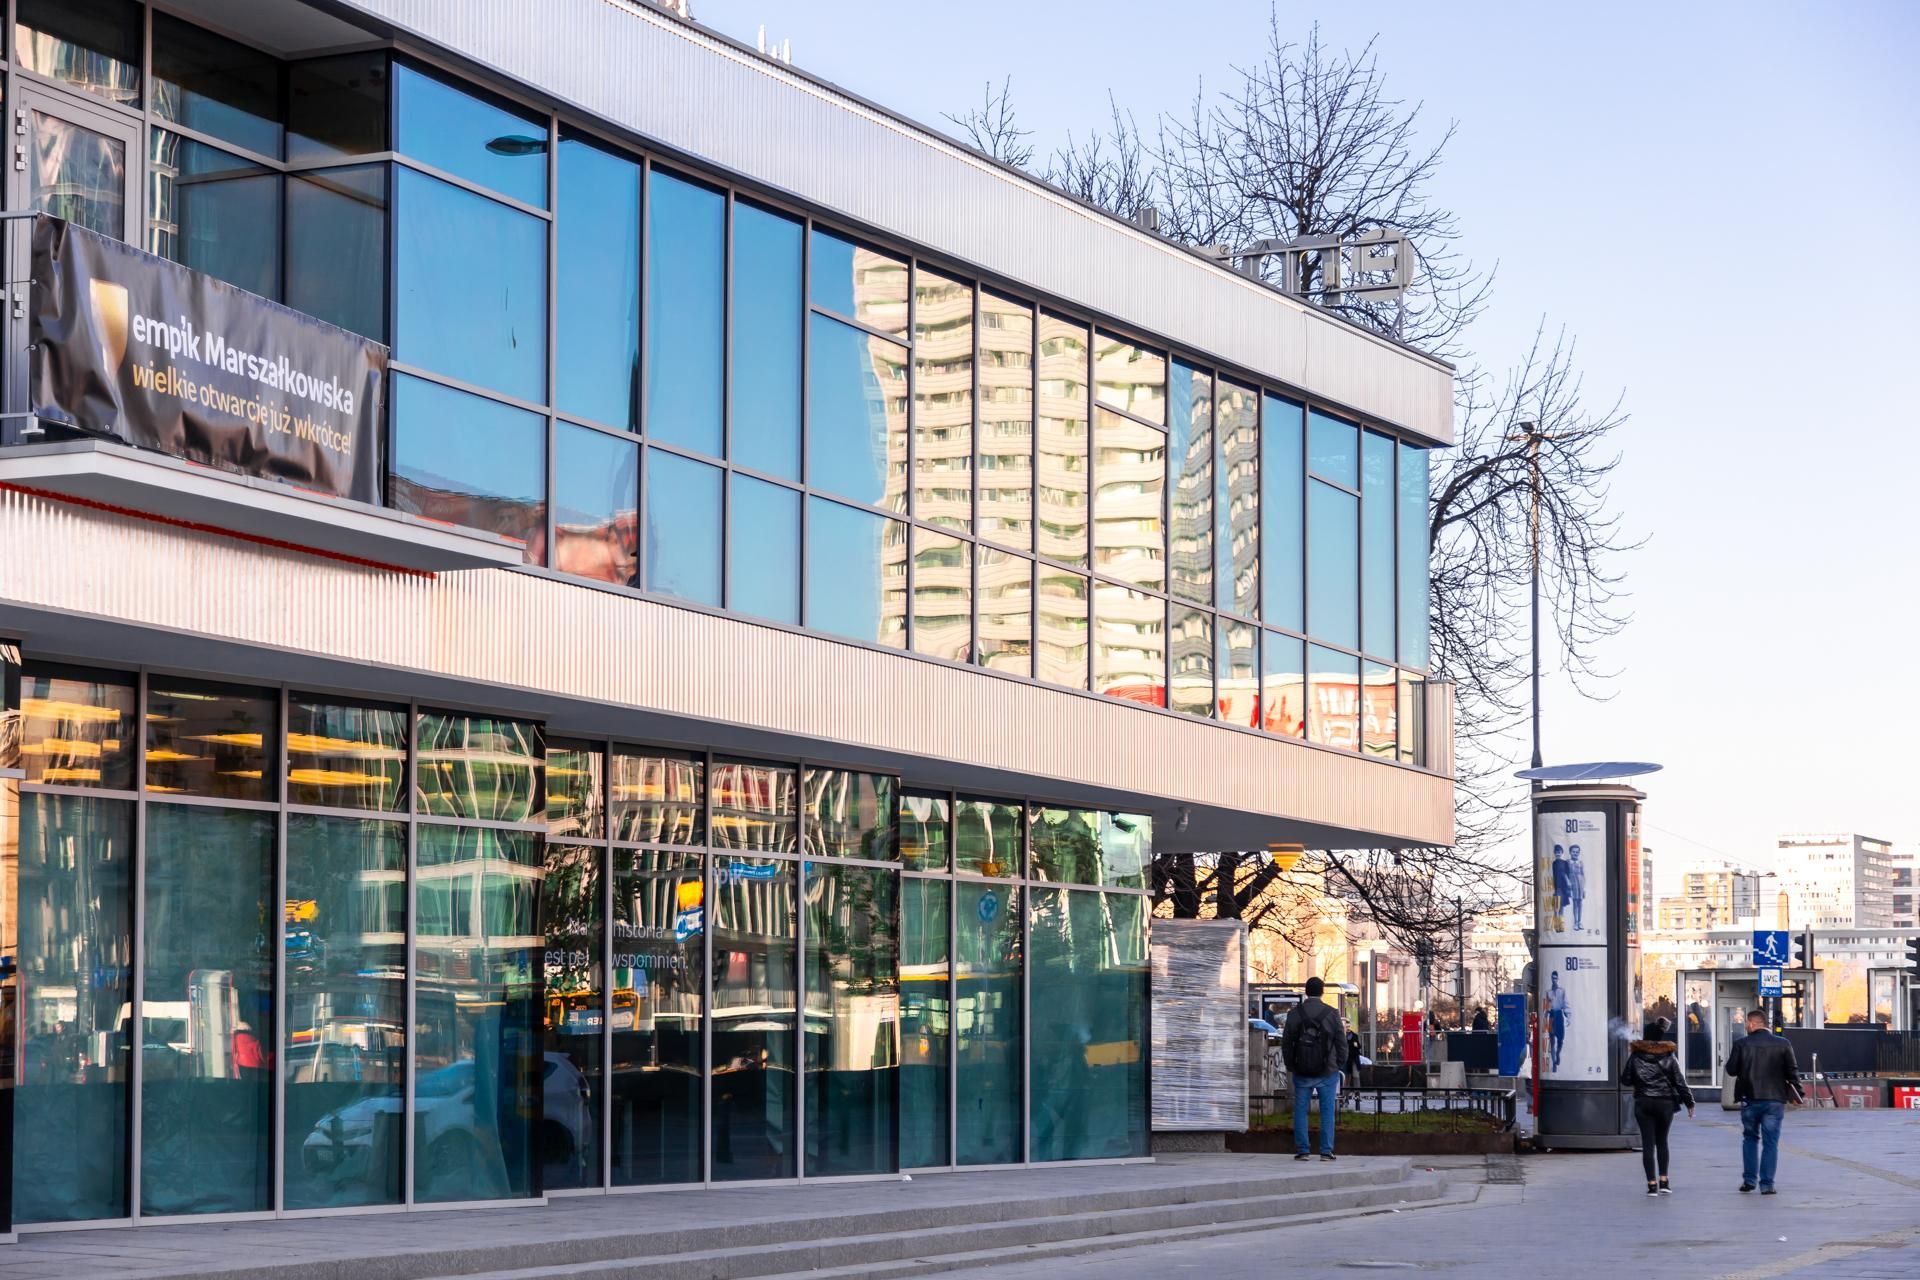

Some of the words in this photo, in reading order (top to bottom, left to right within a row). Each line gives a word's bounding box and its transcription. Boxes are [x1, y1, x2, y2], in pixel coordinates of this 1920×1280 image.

[132, 314, 201, 362] empik
[205, 331, 354, 416] Marszałkowska
[132, 360, 198, 402] wielkie
[199, 383, 268, 426] otwarcie
[269, 401, 292, 434] już
[294, 414, 352, 456] wkrótce!
[1566, 819, 1578, 834] 80
[613, 919, 664, 939] historia
[1566, 957, 1578, 970] 80
